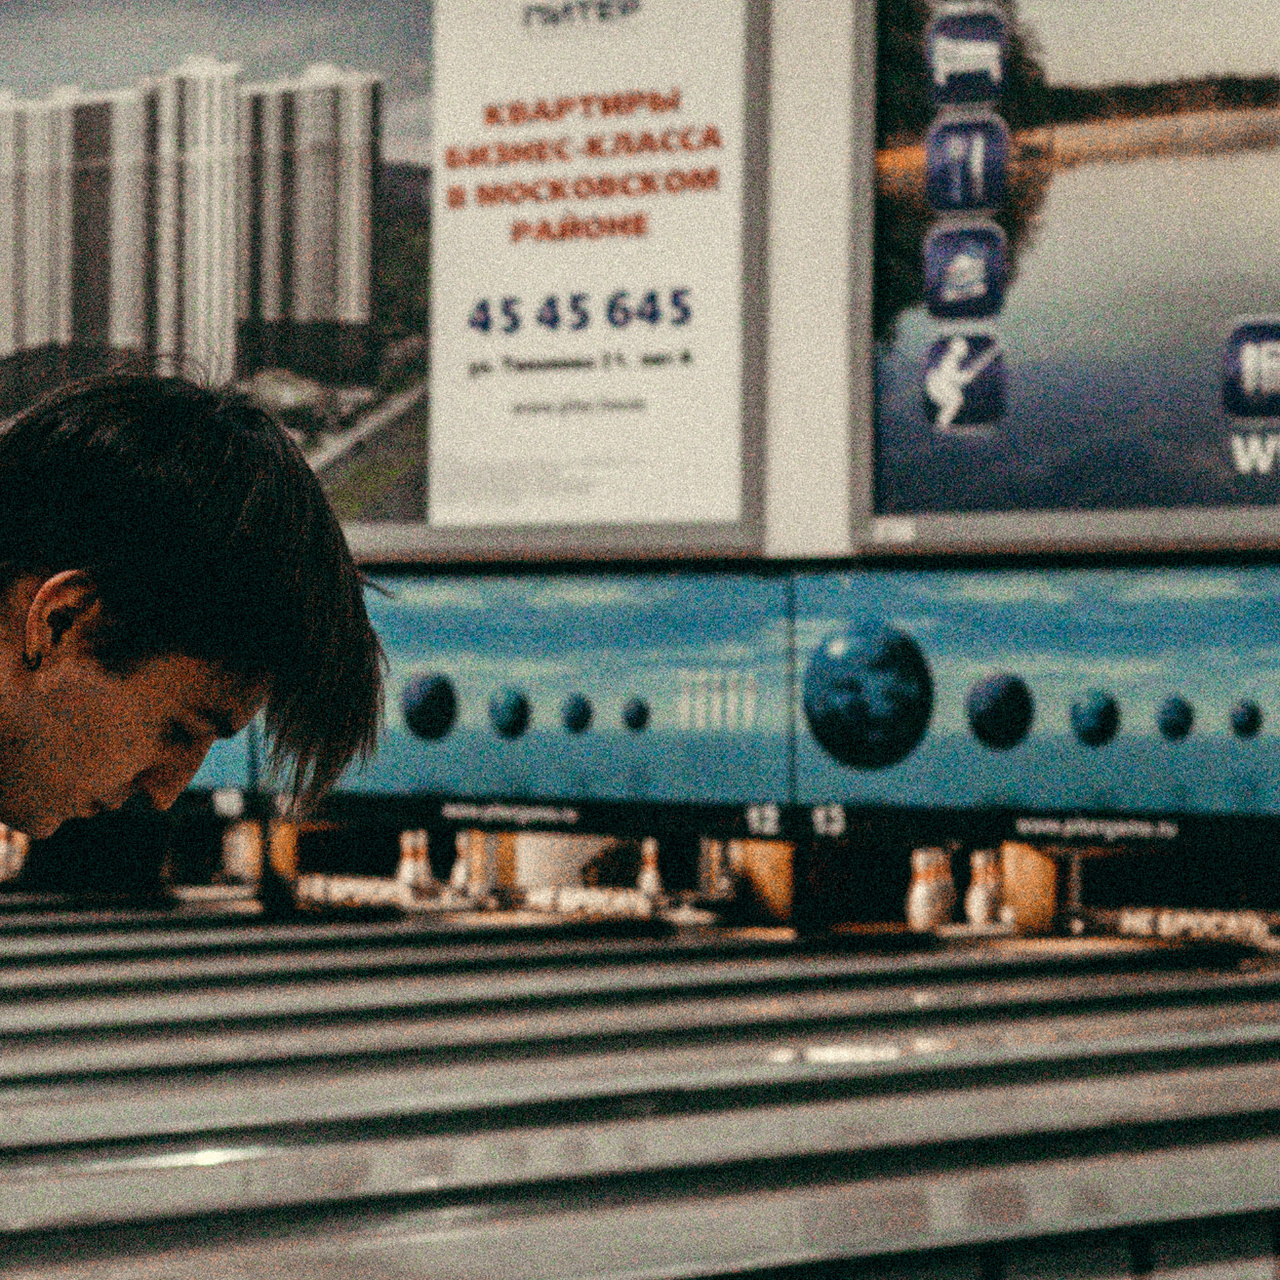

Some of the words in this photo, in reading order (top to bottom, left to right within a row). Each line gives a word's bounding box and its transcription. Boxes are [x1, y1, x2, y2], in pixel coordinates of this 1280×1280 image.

[483, 89, 681, 127] КВАРТИРЫ
[445, 126, 723, 169] БИЗНЕС-КЛАССА
[447, 186, 466, 209] В
[476, 168, 719, 206] МОСКОВСКОМ
[510, 212, 649, 244] РАЙОНЕ
[468, 298, 522, 335] 45
[535, 293, 591, 332] 45
[606, 288, 692, 330] 645
[1232, 434, 1280, 475] W
[747, 803, 780, 835] 12
[813, 803, 846, 836] 13
